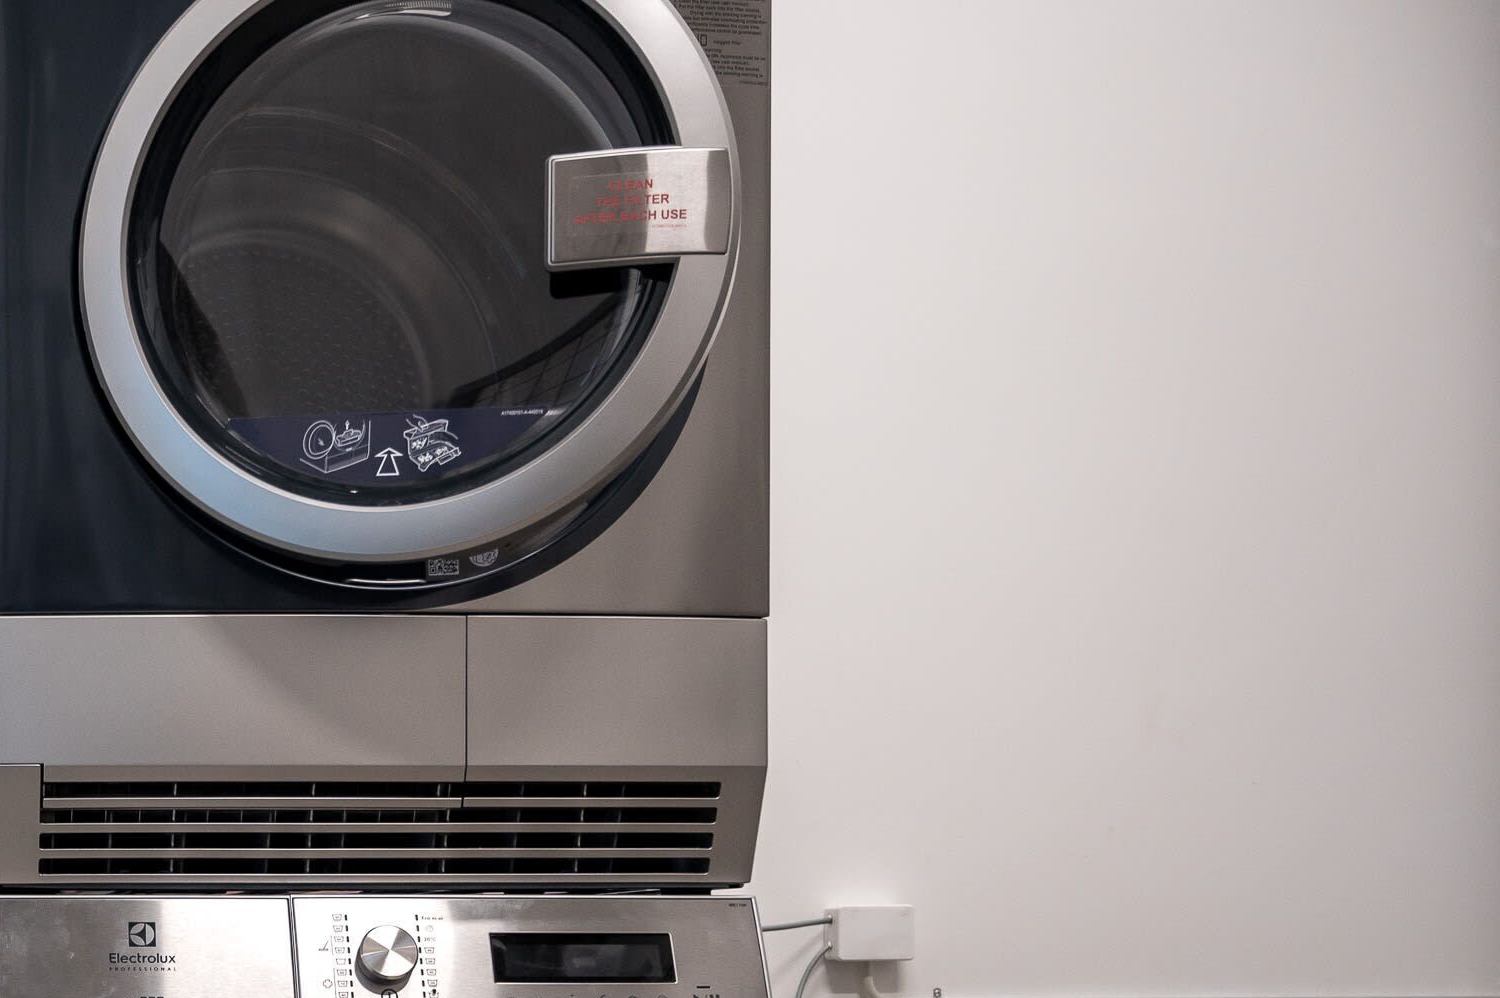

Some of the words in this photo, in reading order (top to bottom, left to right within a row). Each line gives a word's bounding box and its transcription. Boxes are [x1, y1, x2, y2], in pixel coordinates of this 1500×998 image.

[608, 179, 653, 190] CLEAN
[661, 209, 687, 220] USE
[109, 953, 176, 964] Electrolux
